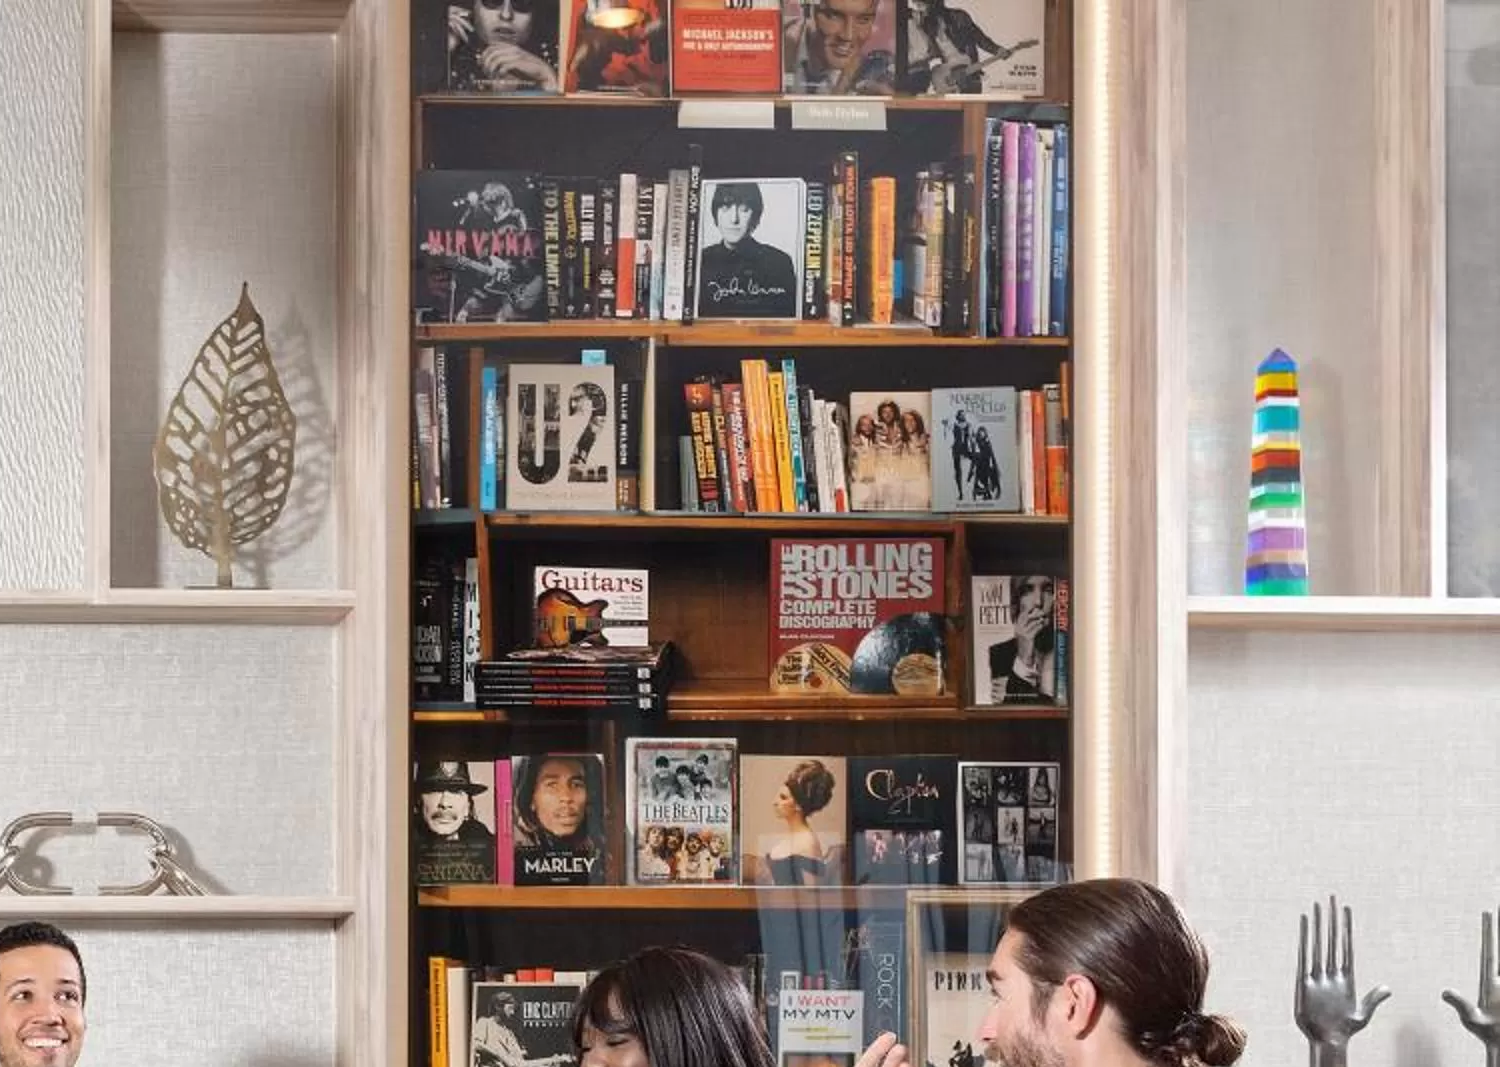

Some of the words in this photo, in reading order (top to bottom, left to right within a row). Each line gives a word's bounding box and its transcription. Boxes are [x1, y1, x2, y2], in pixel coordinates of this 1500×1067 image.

[683, 29, 722, 40] MICHAEL
[725, 29, 773, 40] JACKSON'S
[691, 166, 700, 188] BON
[991, 143, 1001, 199] SINATRA
[545, 189, 558, 207] TO
[581, 194, 594, 219] BILLY
[638, 185, 652, 235] Miles
[689, 190, 698, 213] JOVI
[807, 189, 822, 211] LED
[544, 210, 559, 241] THE
[427, 229, 534, 258] NIRVANA
[806, 213, 821, 268] ZEPPELIN
[545, 243, 560, 287] LIMIT
[620, 383, 628, 420] WILLIE
[517, 382, 608, 485] U2
[619, 422, 628, 465] NELSON
[792, 543, 933, 571] ROLLING
[541, 569, 644, 593] Guitars
[781, 543, 793, 598] THE
[792, 572, 933, 599] STONES
[780, 600, 876, 615] COMPLETE
[980, 605, 1011, 624] PETT
[1057, 580, 1068, 631] MERCURY
[466, 582, 477, 682] MICK
[780, 616, 876, 629] DISCOGRAPHY
[866, 769, 939, 815] Clapton
[643, 804, 670, 819] THE
[673, 802, 728, 821] BEATLES
[418, 863, 489, 880] SANTANA
[525, 857, 595, 873] MARLEY
[877, 953, 894, 1009] ROCK
[934, 971, 982, 991] PINK
[788, 996, 793, 1006] I
[797, 996, 852, 1006] WANT
[783, 1010, 811, 1020] MY
[815, 1010, 855, 1020] MTV
